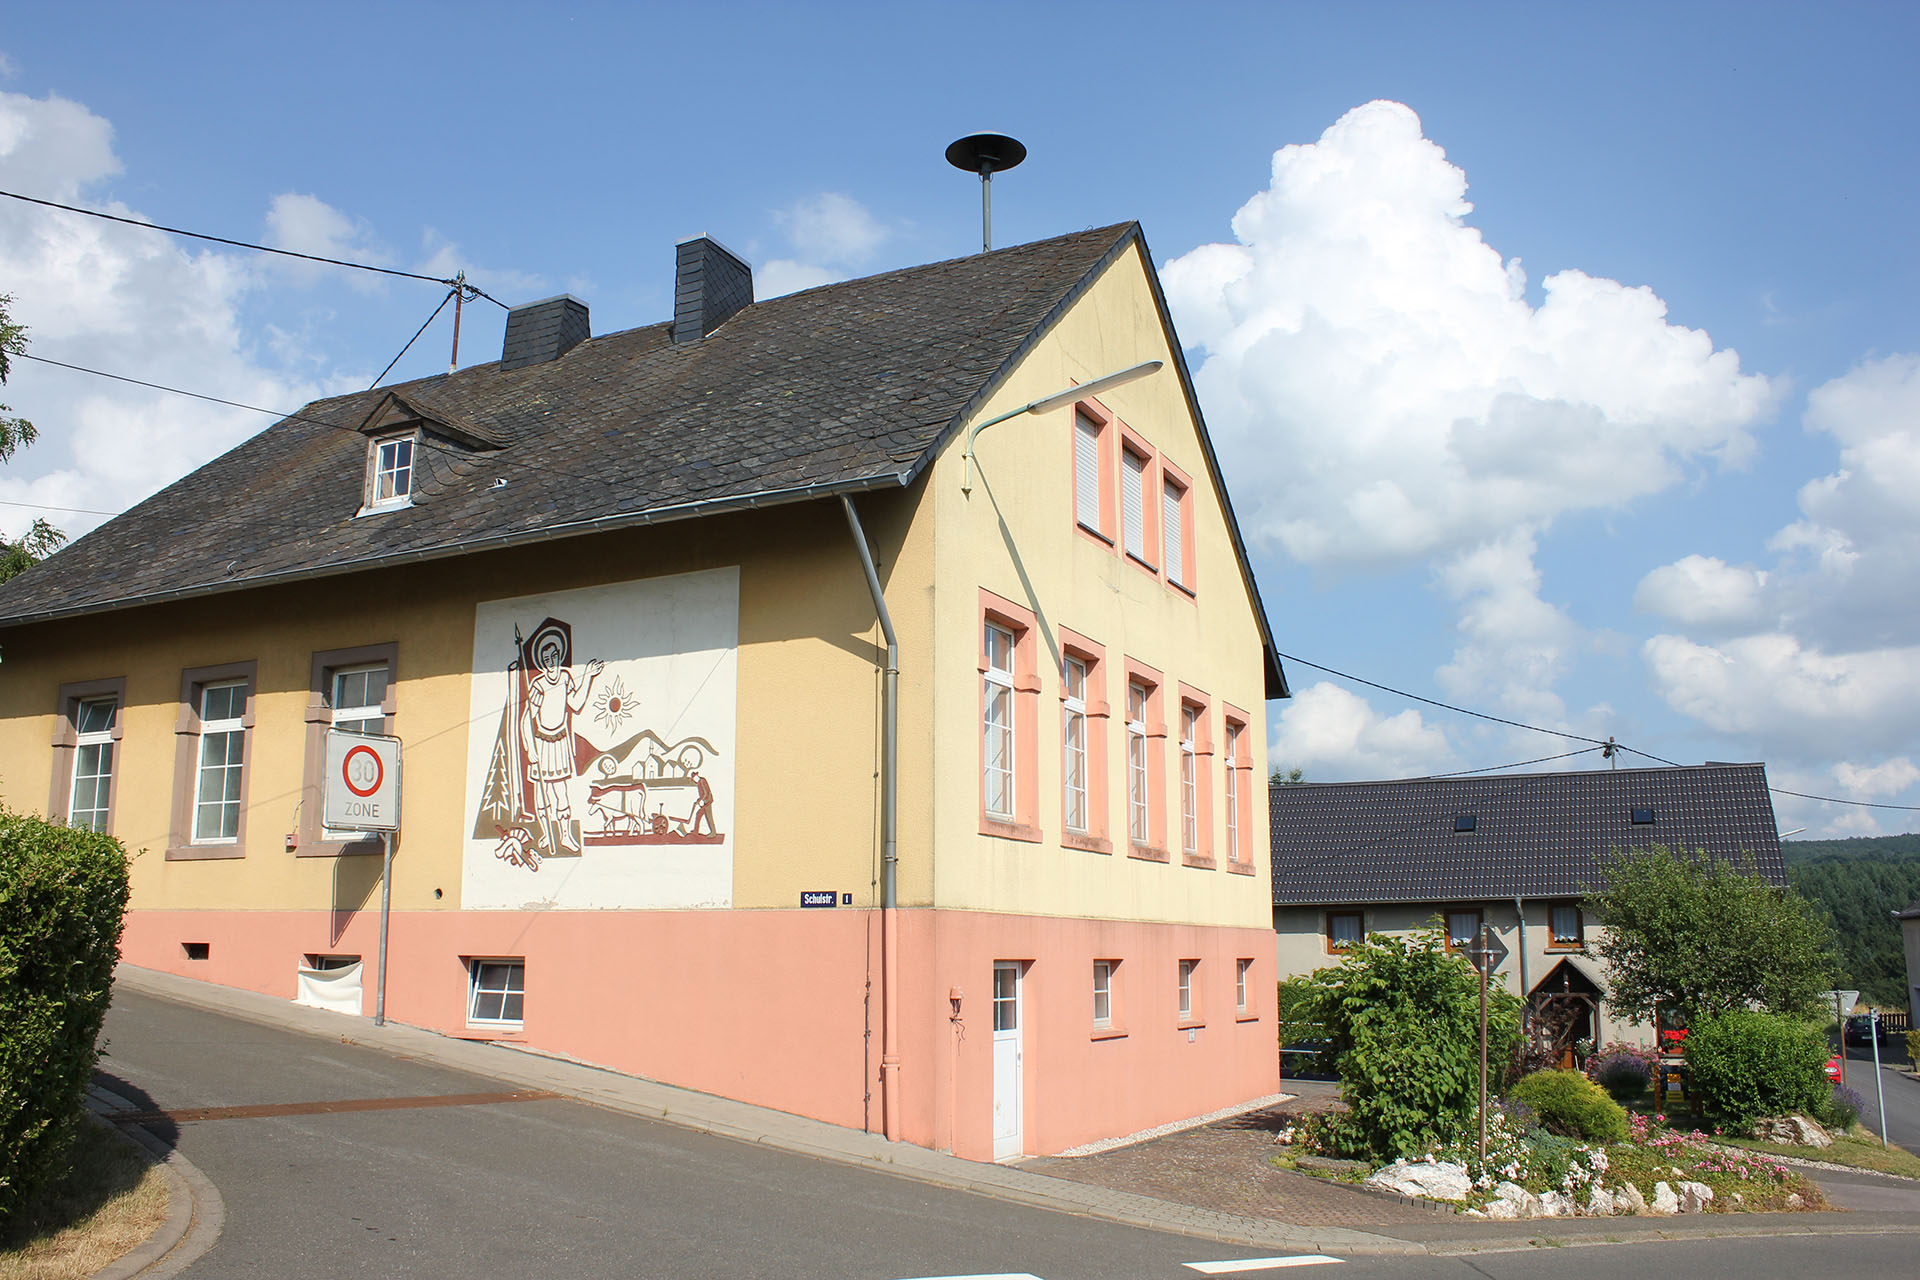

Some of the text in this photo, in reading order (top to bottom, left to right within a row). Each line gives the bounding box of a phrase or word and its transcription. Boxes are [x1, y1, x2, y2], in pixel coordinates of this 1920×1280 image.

[351, 759, 375, 783] 30
[344, 801, 380, 818] ZONE
[804, 893, 834, 904] Schulstr.
